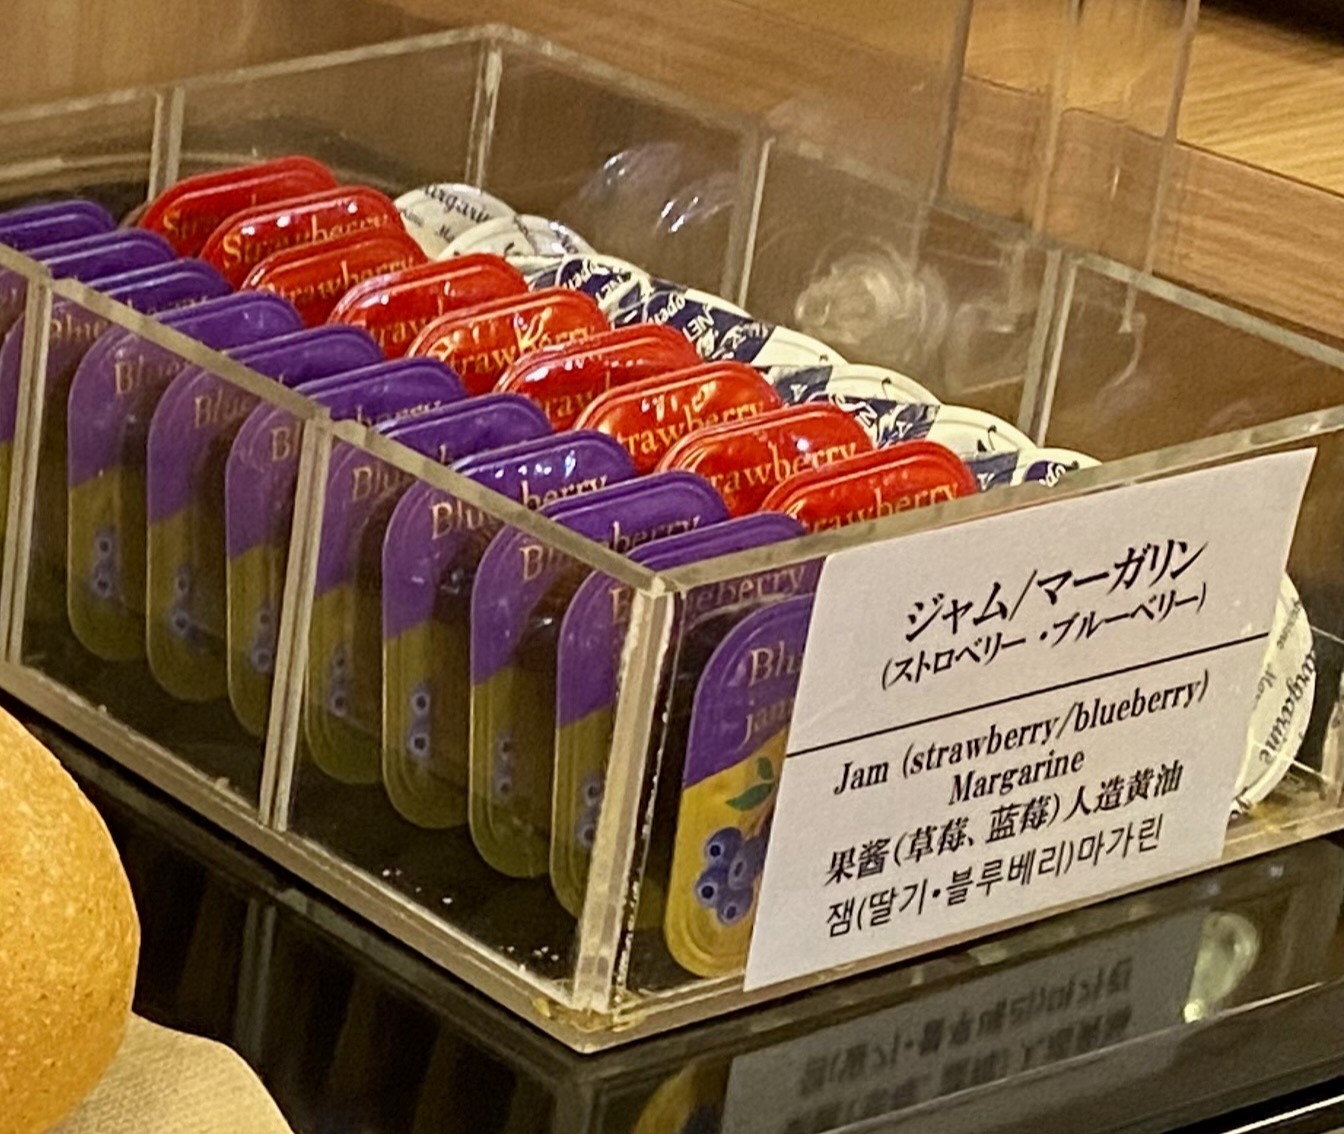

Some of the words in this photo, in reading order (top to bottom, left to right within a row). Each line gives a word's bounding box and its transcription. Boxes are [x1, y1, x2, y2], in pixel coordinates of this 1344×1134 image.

[904, 538, 1209, 643] ジャム/マーガリン
[832, 760, 889, 796] Jam
[901, 668, 1209, 779] (strawberry/blueberry)
[947, 748, 1086, 806] Margarine
